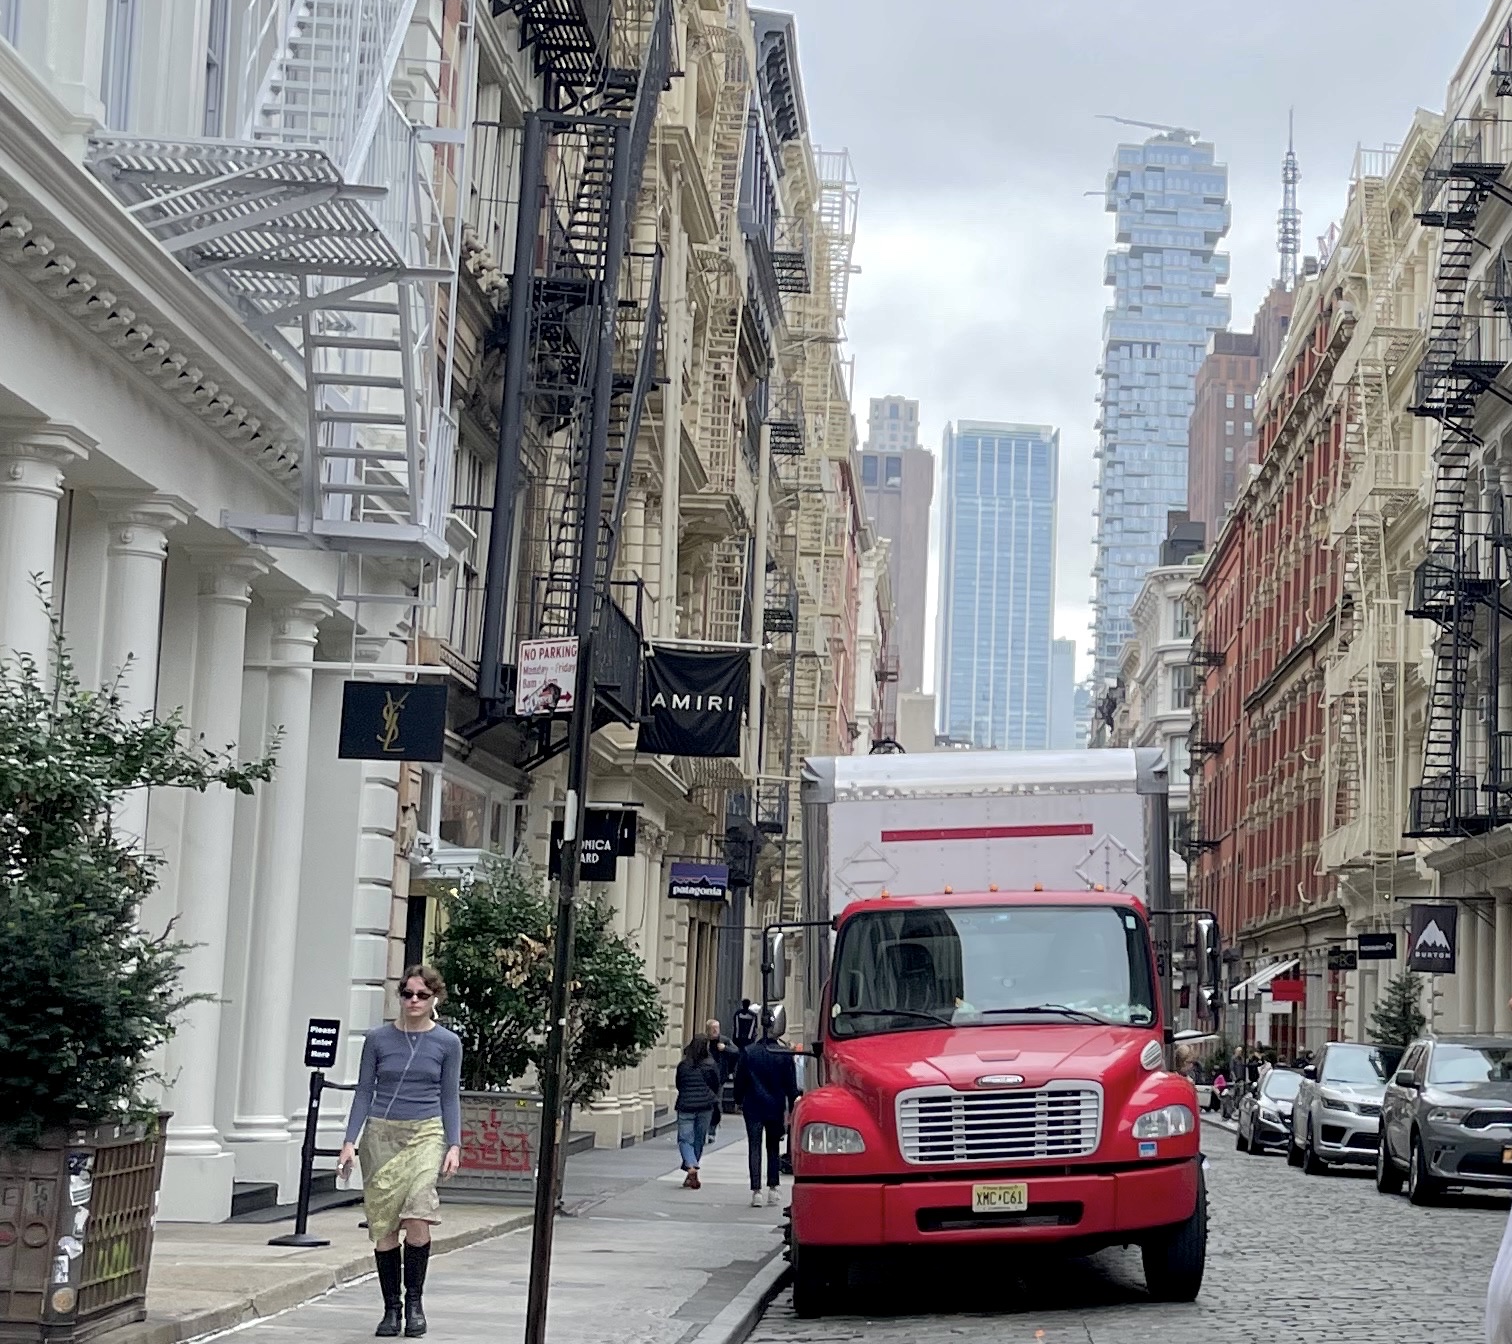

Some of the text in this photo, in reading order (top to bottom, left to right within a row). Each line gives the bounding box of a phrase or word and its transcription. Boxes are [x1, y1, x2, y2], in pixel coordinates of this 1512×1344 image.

[524, 645, 577, 661] NO PARKING
[651, 692, 733, 712] AMIRI
[672, 885, 722, 897] patagonia
[1415, 951, 1451, 959] BURTON
[310, 1025, 337, 1034] Please
[311, 1037, 333, 1046] Enter
[311, 1050, 330, 1058] Here
[1003, 1190, 1023, 1204] C61
